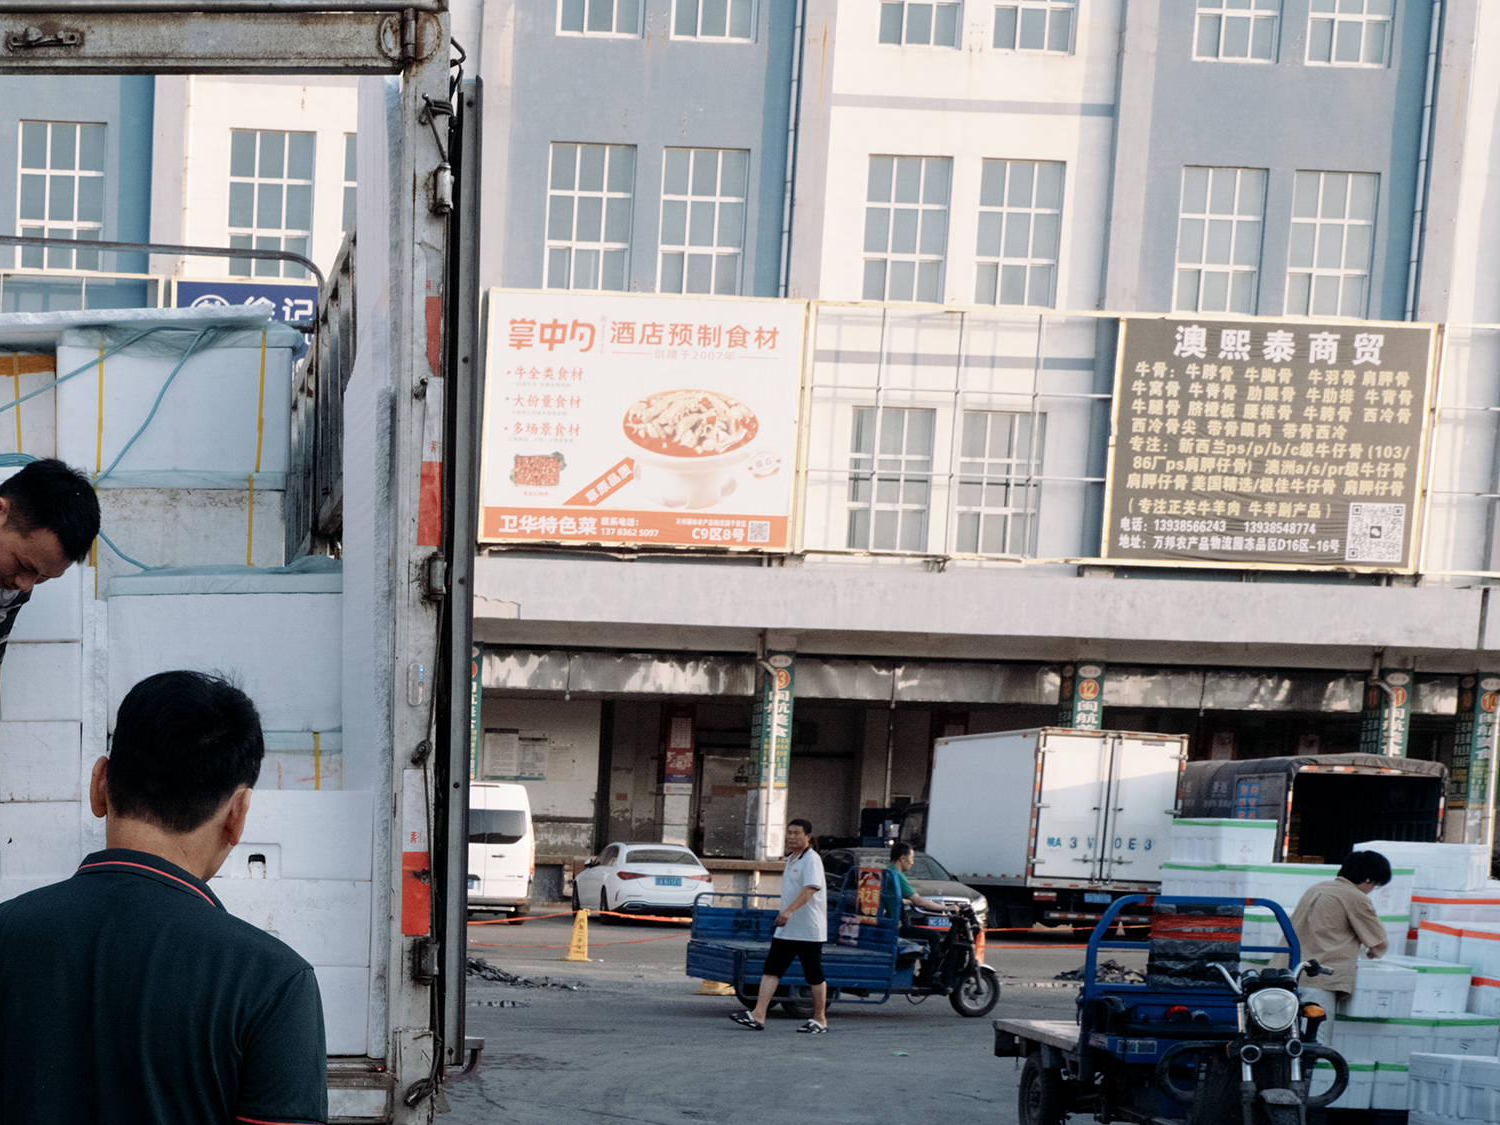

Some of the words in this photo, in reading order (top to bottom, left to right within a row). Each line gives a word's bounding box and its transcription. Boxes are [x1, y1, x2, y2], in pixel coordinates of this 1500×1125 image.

[610, 320, 780, 350] 酒店预制食材
[1173, 325, 1385, 366] 澳熙泰商贸
[1363, 407, 1411, 425] 西冷骨
[1131, 418, 1197, 436] 西冷骨尖
[498, 515, 597, 536] 卫华特色菜
[1244, 522, 1316, 536] 13938548774
[692, 528, 744, 542] C9区8号
[1082, 681, 1095, 698] 12
